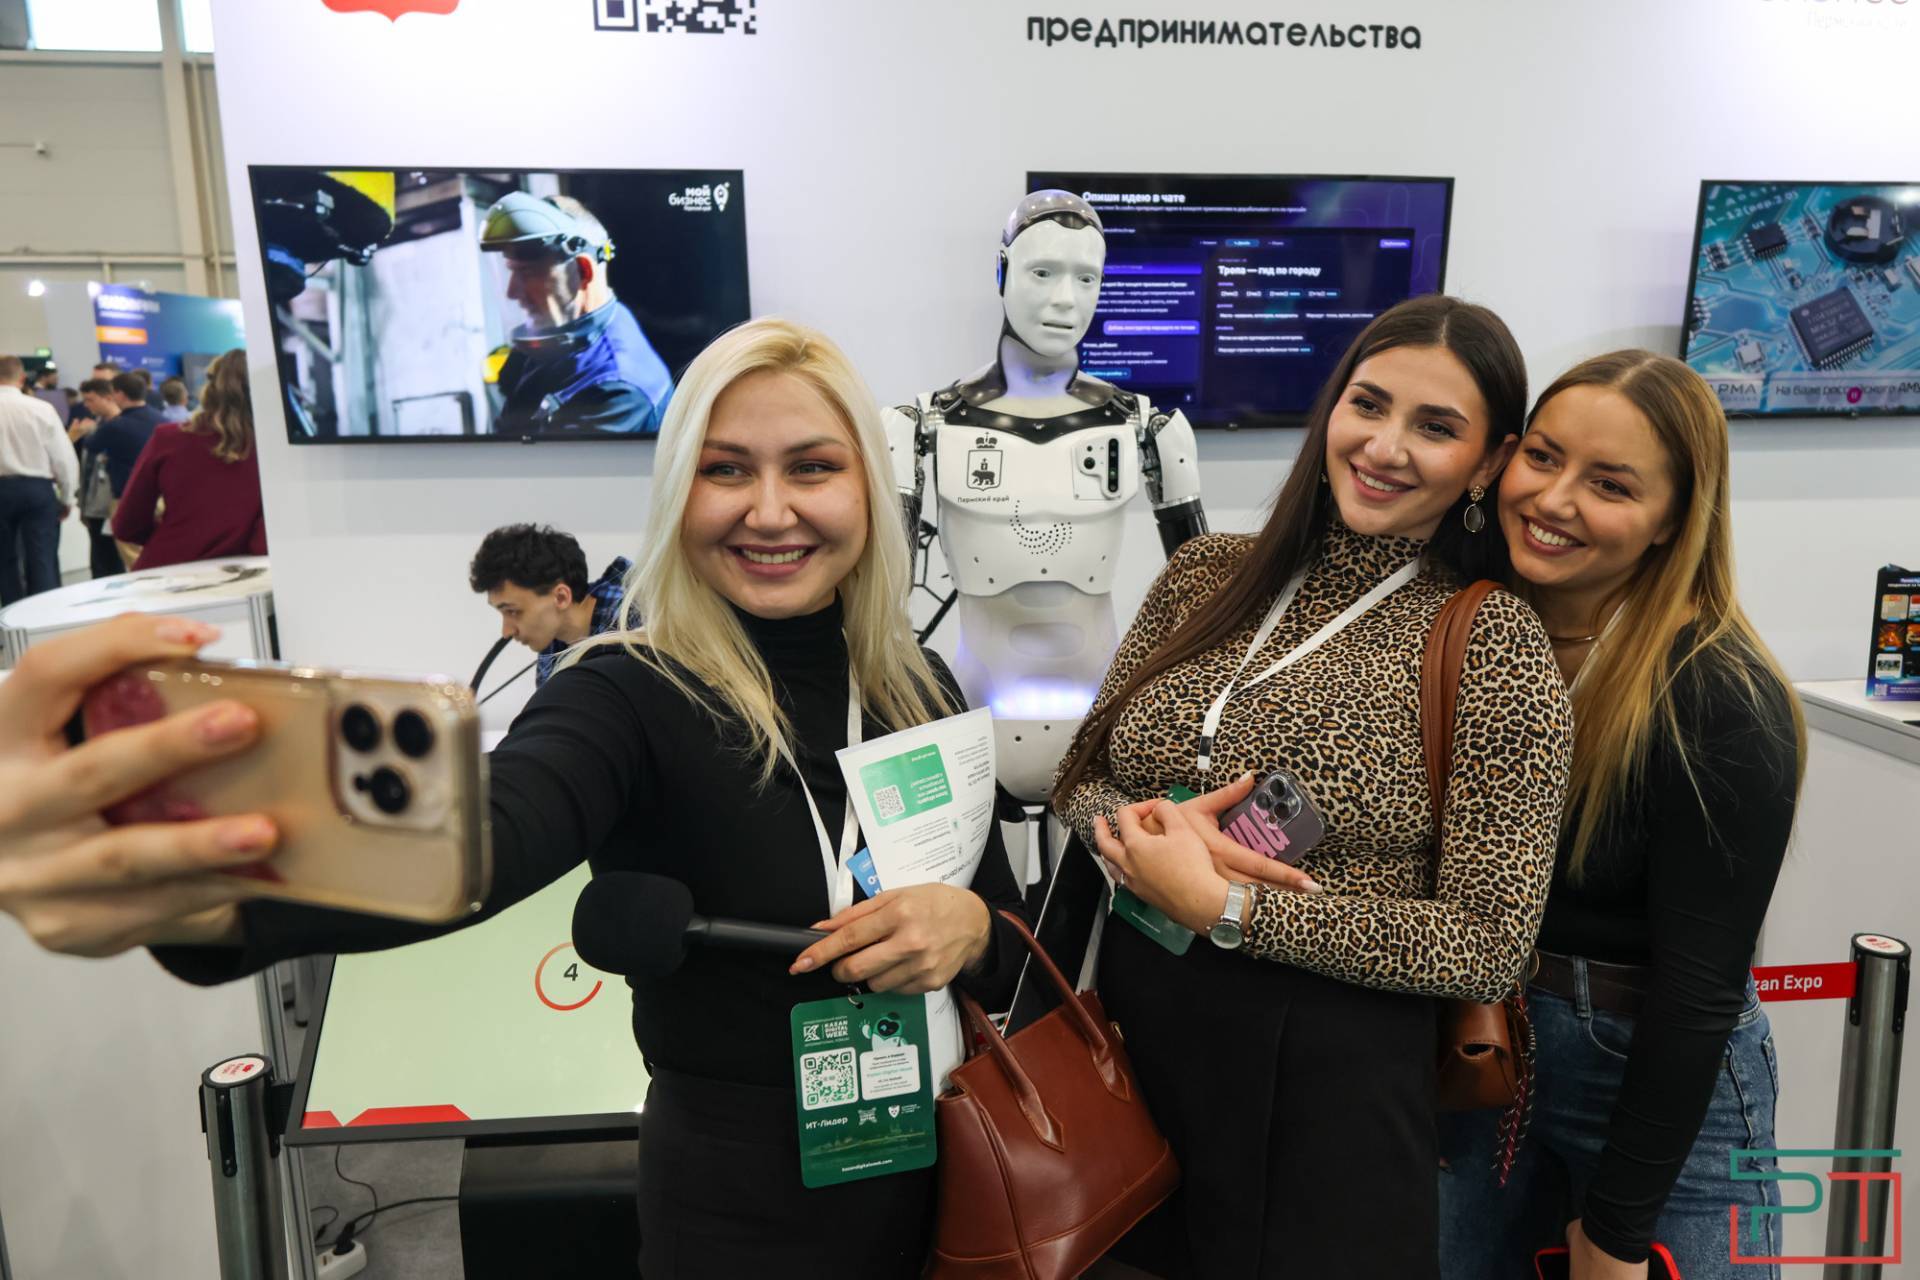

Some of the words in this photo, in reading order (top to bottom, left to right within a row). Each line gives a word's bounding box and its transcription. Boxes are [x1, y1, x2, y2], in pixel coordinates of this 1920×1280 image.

[1026, 15, 1422, 49] предпринимательства
[1082, 191, 1120, 202] Опиши
[1121, 193, 1151, 204] идею
[1152, 194, 1160, 203] в
[1161, 194, 1185, 203] чате
[1217, 265, 1246, 277] Тропа
[1258, 267, 1275, 276] гид
[1275, 267, 1288, 275] по
[1288, 267, 1321, 277] городу
[563, 962, 579, 982] 4
[1784, 974, 1823, 993] Expo
